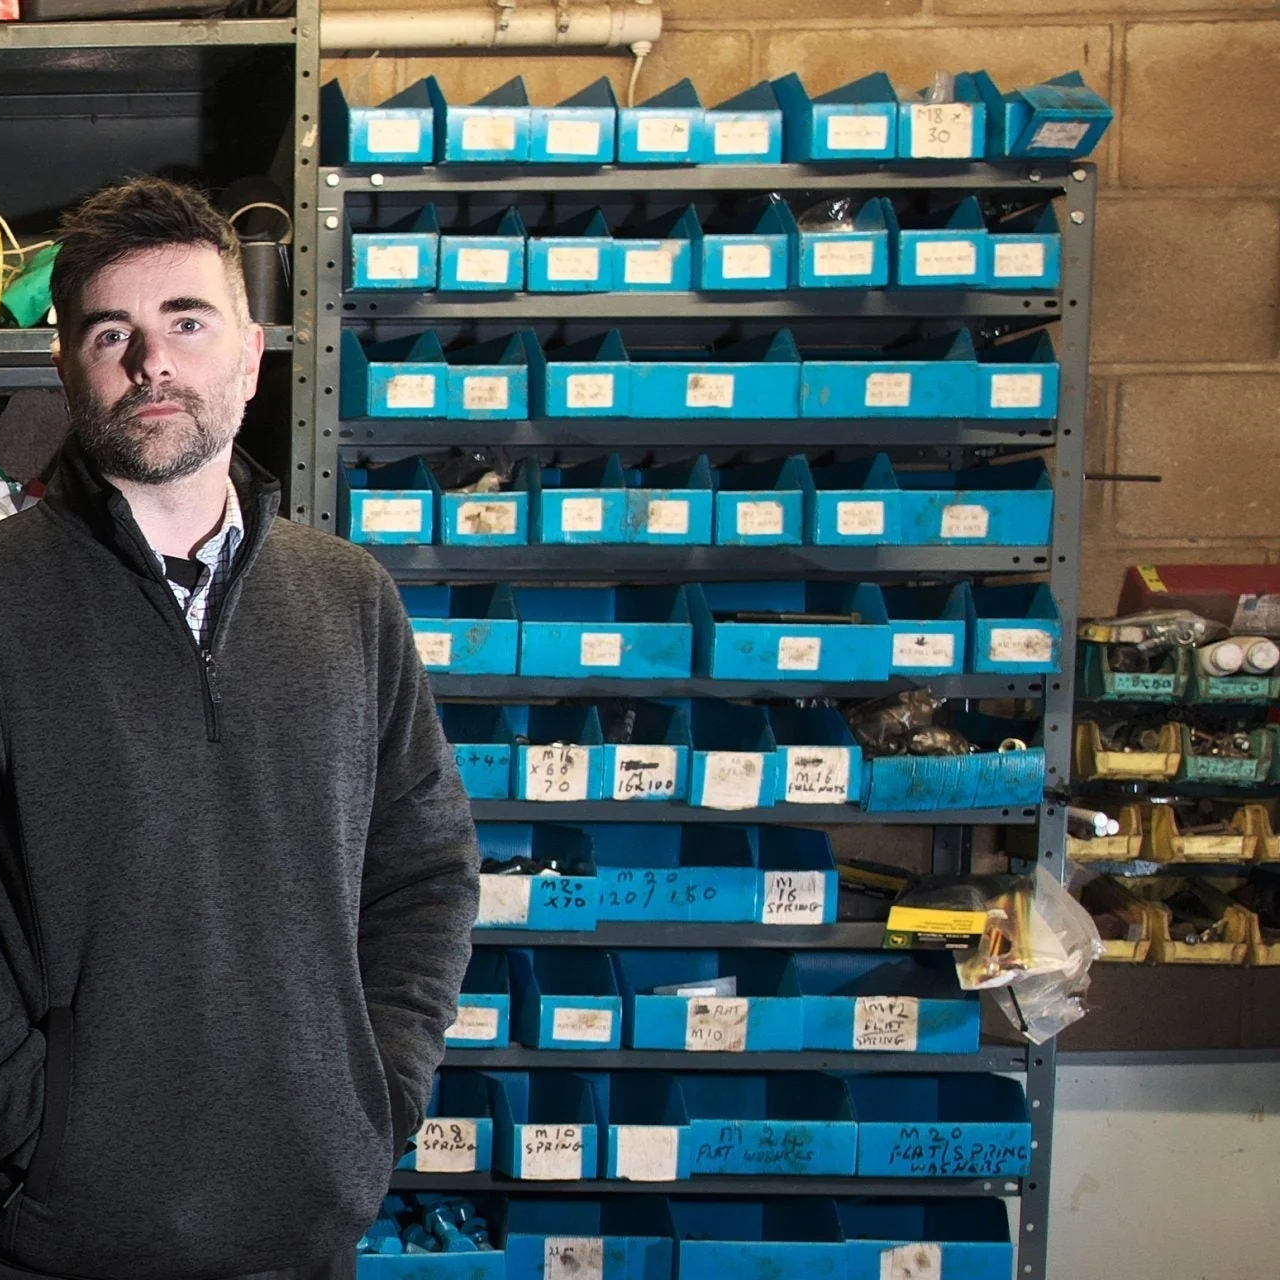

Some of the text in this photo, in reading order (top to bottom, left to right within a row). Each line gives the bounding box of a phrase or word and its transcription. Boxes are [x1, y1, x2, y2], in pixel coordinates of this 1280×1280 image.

[914, 106, 944, 125] M8
[927, 126, 953, 145] 30
[543, 780, 570, 793] 70
[777, 889, 797, 902] 16
[766, 902, 822, 914] SPRING
[690, 1027, 723, 1041] M10
[424, 1122, 462, 1143] M8
[534, 1129, 576, 1141] M10
[899, 1127, 963, 1142] M20
[422, 1139, 477, 1152] SPRING
[525, 1142, 583, 1155] SPRING
